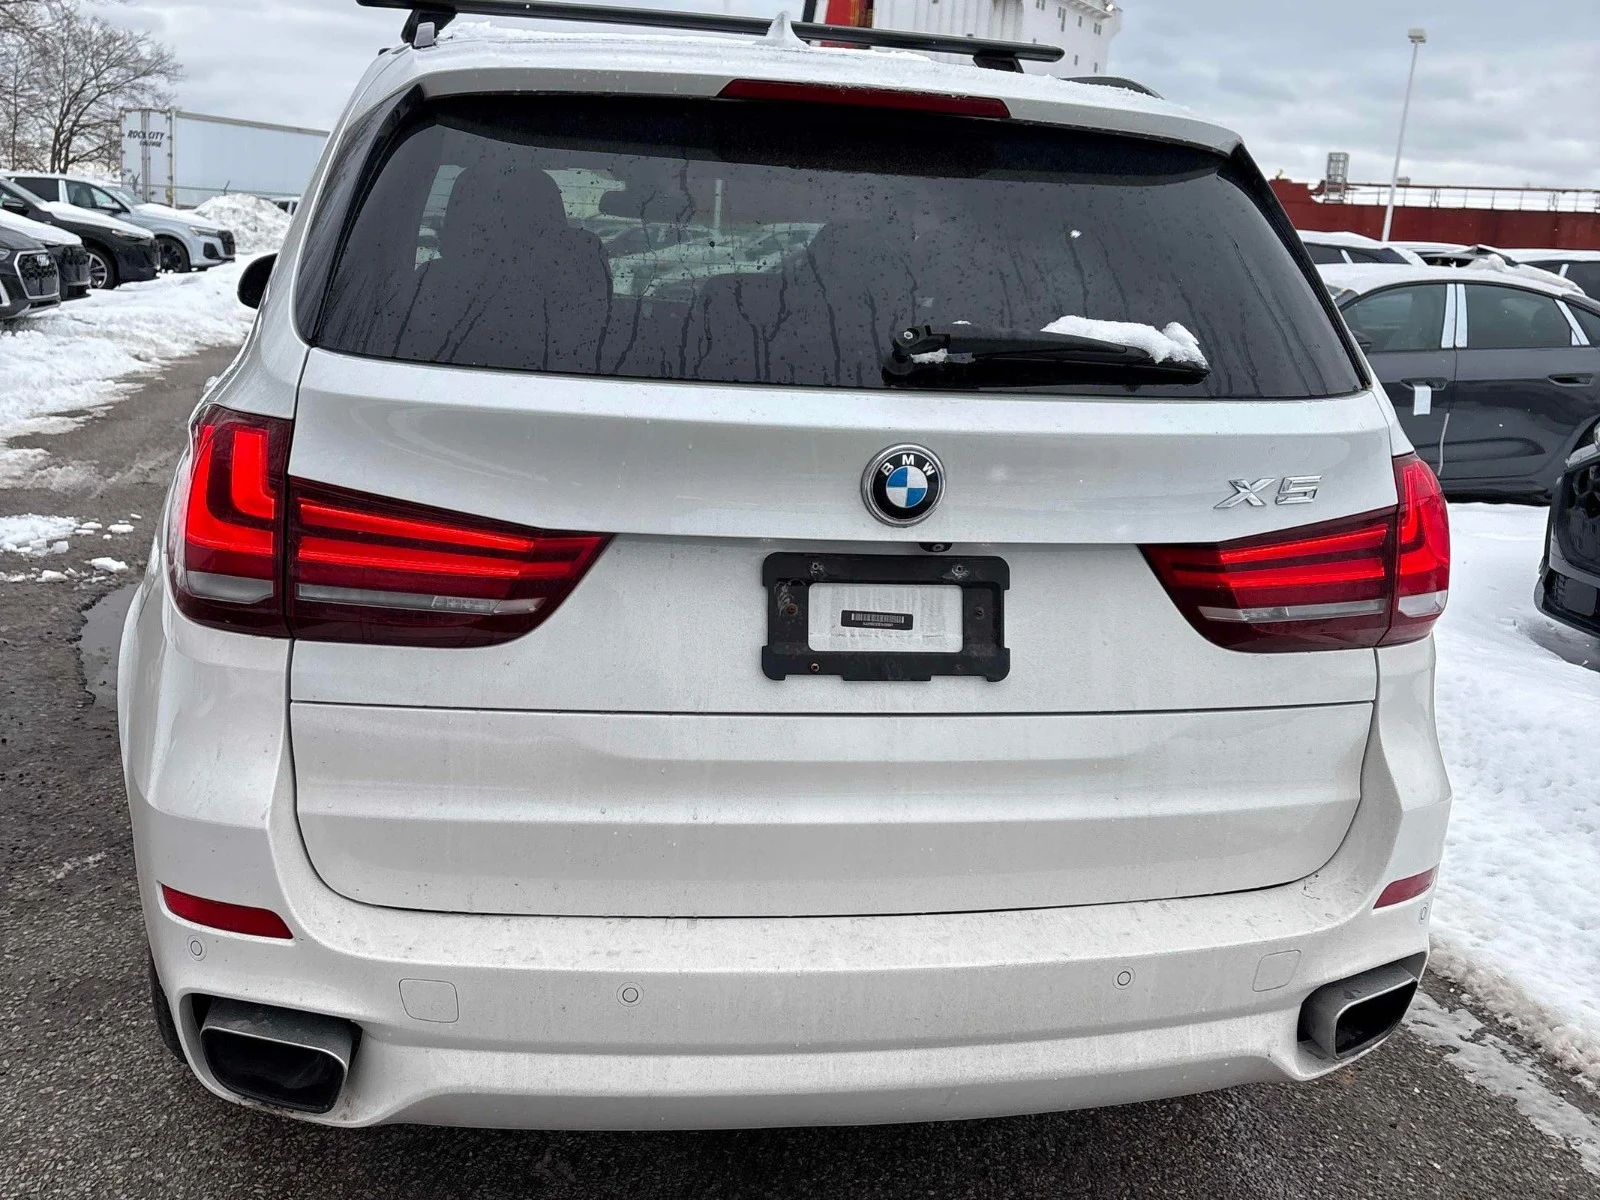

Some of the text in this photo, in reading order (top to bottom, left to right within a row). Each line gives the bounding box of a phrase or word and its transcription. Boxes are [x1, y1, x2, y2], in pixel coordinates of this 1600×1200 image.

[127, 129, 165, 140] ROCK CITY
[880, 454, 936, 477] BMW
[1213, 475, 1322, 510] X5
